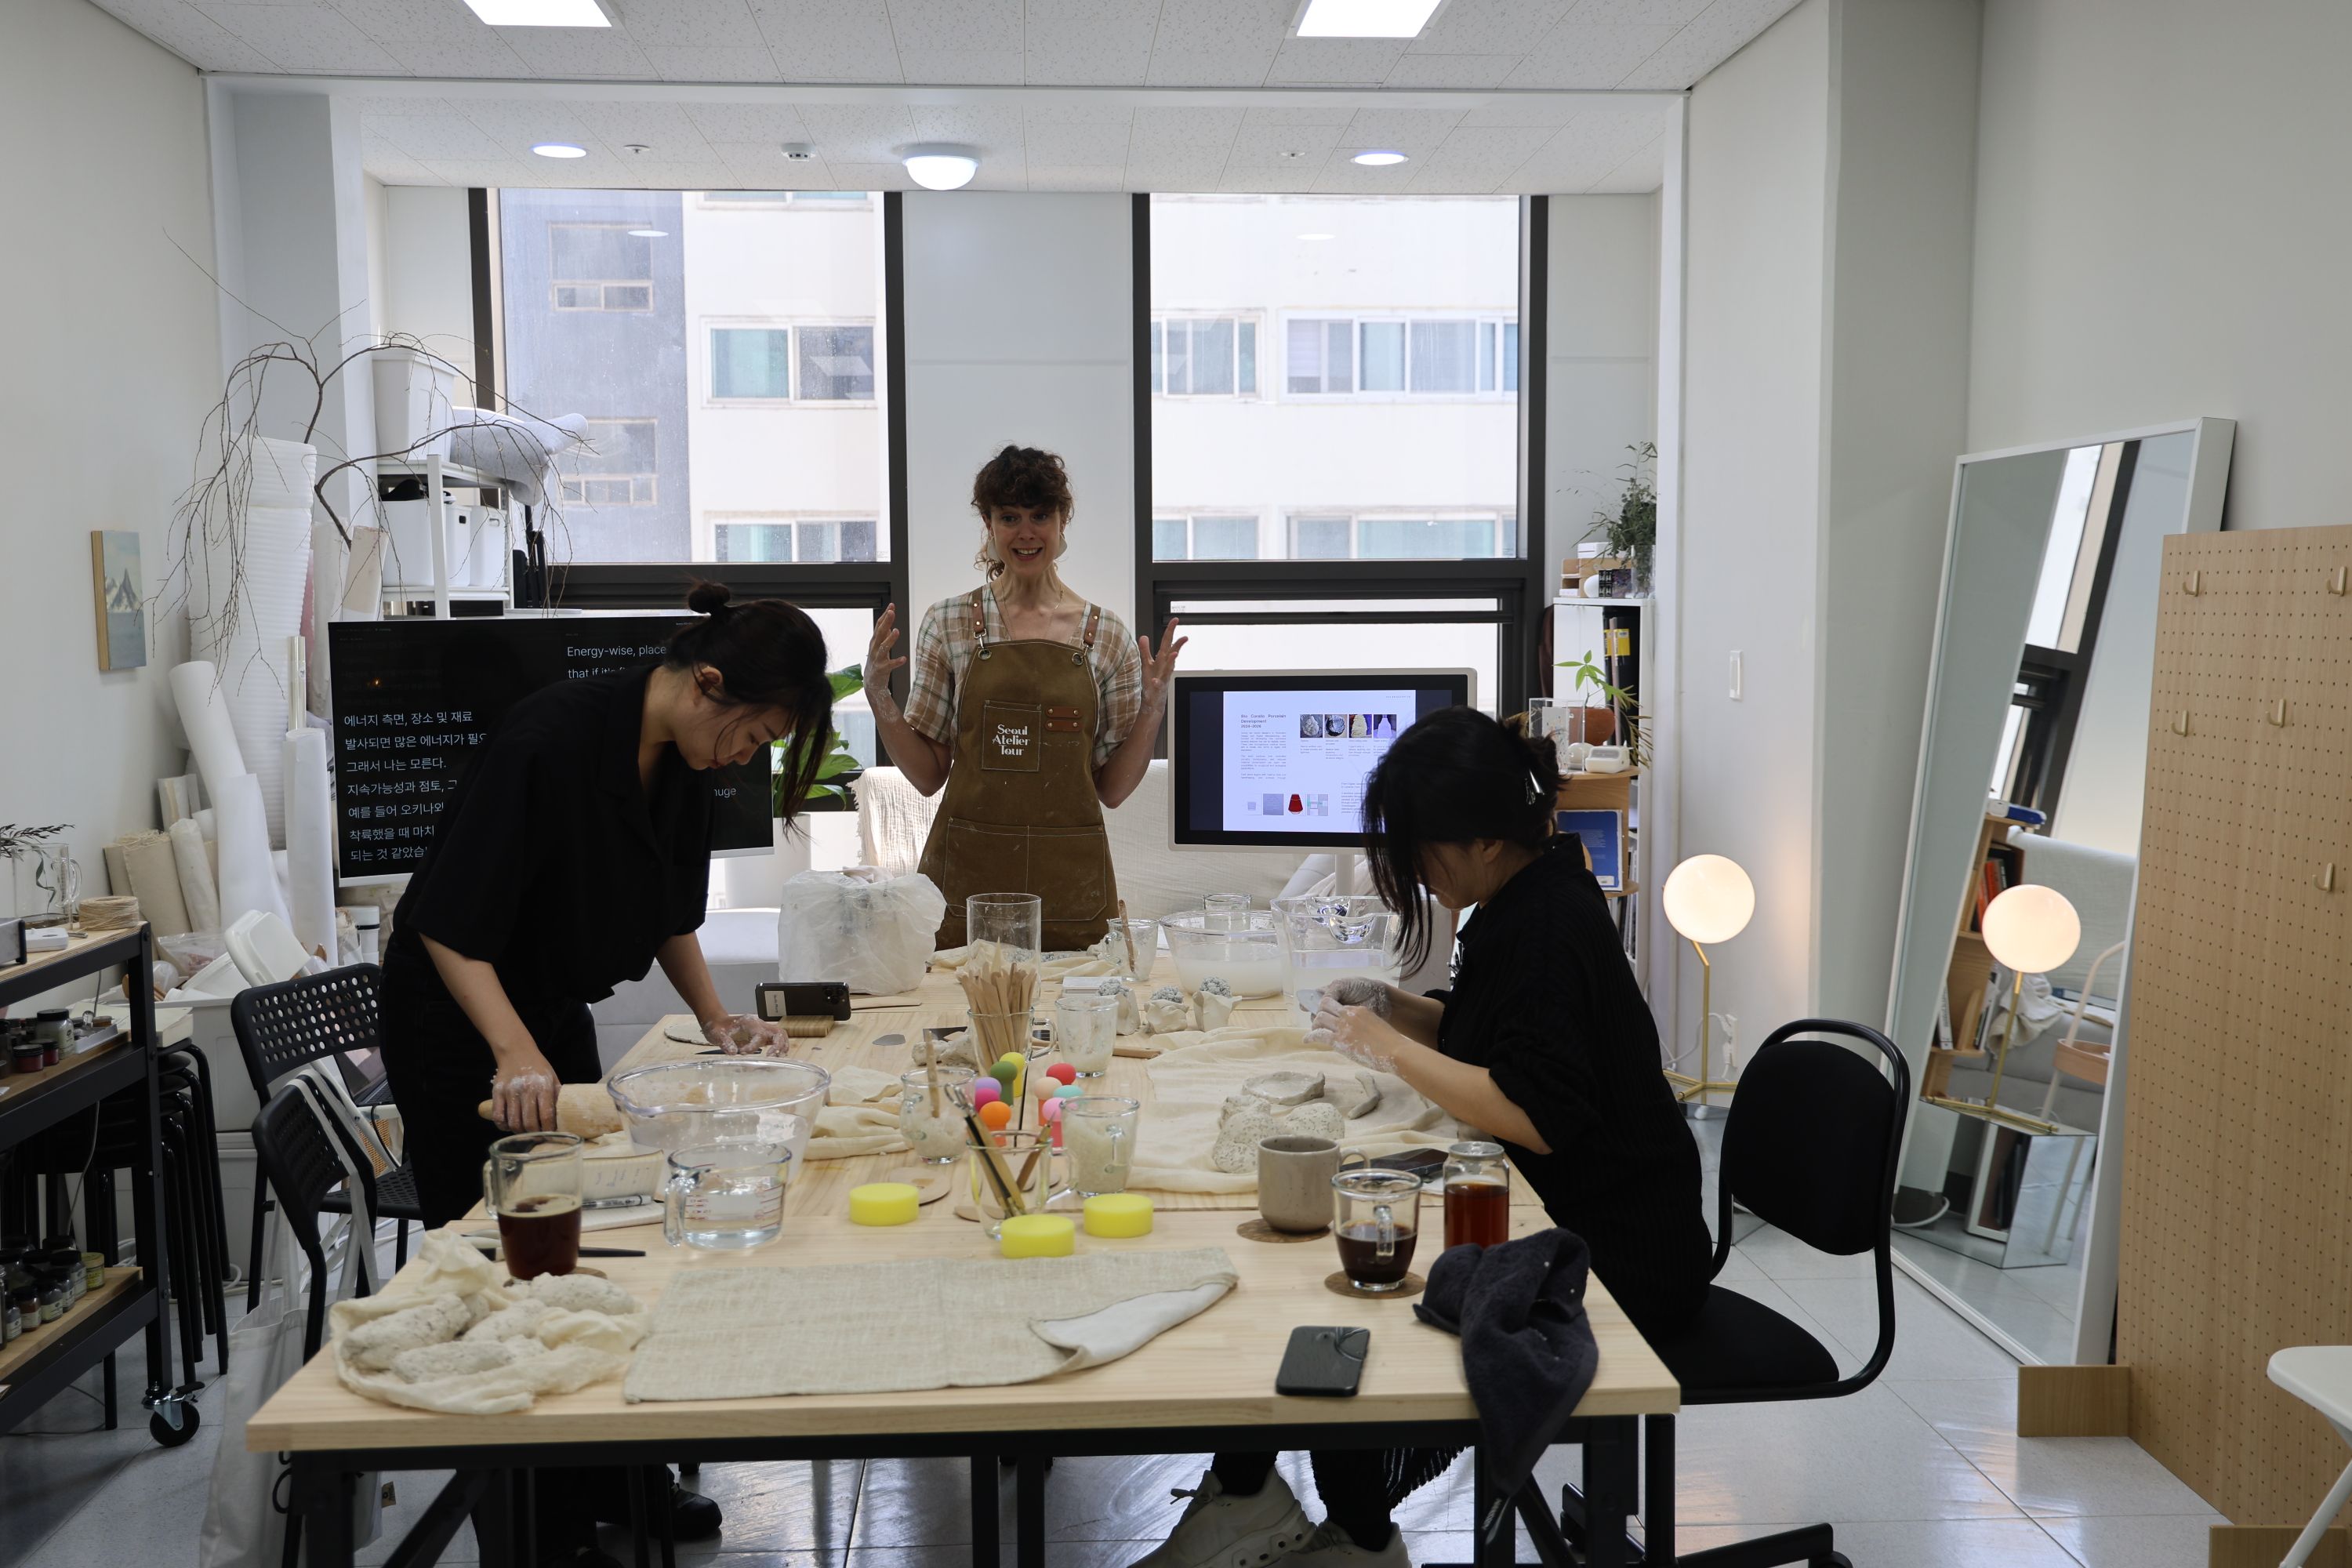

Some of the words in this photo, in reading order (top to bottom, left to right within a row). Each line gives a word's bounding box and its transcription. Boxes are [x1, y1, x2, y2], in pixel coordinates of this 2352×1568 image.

[568, 646, 635, 658] Energy-wise,
[568, 669, 589, 678] that
[344, 714, 378, 727] 에너지
[383, 713, 407, 726] 측면,
[412, 713, 434, 724] 장소
[437, 712, 447, 723] 및
[452, 711, 473, 722] 재료
[997, 724, 1028, 735] Seoul
[346, 737, 390, 750] 발사되면
[395, 736, 416, 747] 많은
[420, 734, 464, 746] 에너지가
[992, 735, 1031, 746] Atelier
[999, 745, 1025, 756] Tour
[347, 760, 379, 771] 그래서
[385, 760, 406, 771] 나는
[410, 757, 446, 769] 모른다.
[348, 781, 416, 796] 지속가능성과
[419, 780, 444, 793] 점토,
[349, 807, 371, 818] 예를
[375, 804, 396, 817] 들어
[350, 828, 394, 841] 착륙했을
[399, 827, 409, 838] 때
[413, 825, 434, 837] 마치
[351, 850, 372, 861] 되는
[377, 848, 387, 859] 것
[392, 846, 426, 858] 같았습
